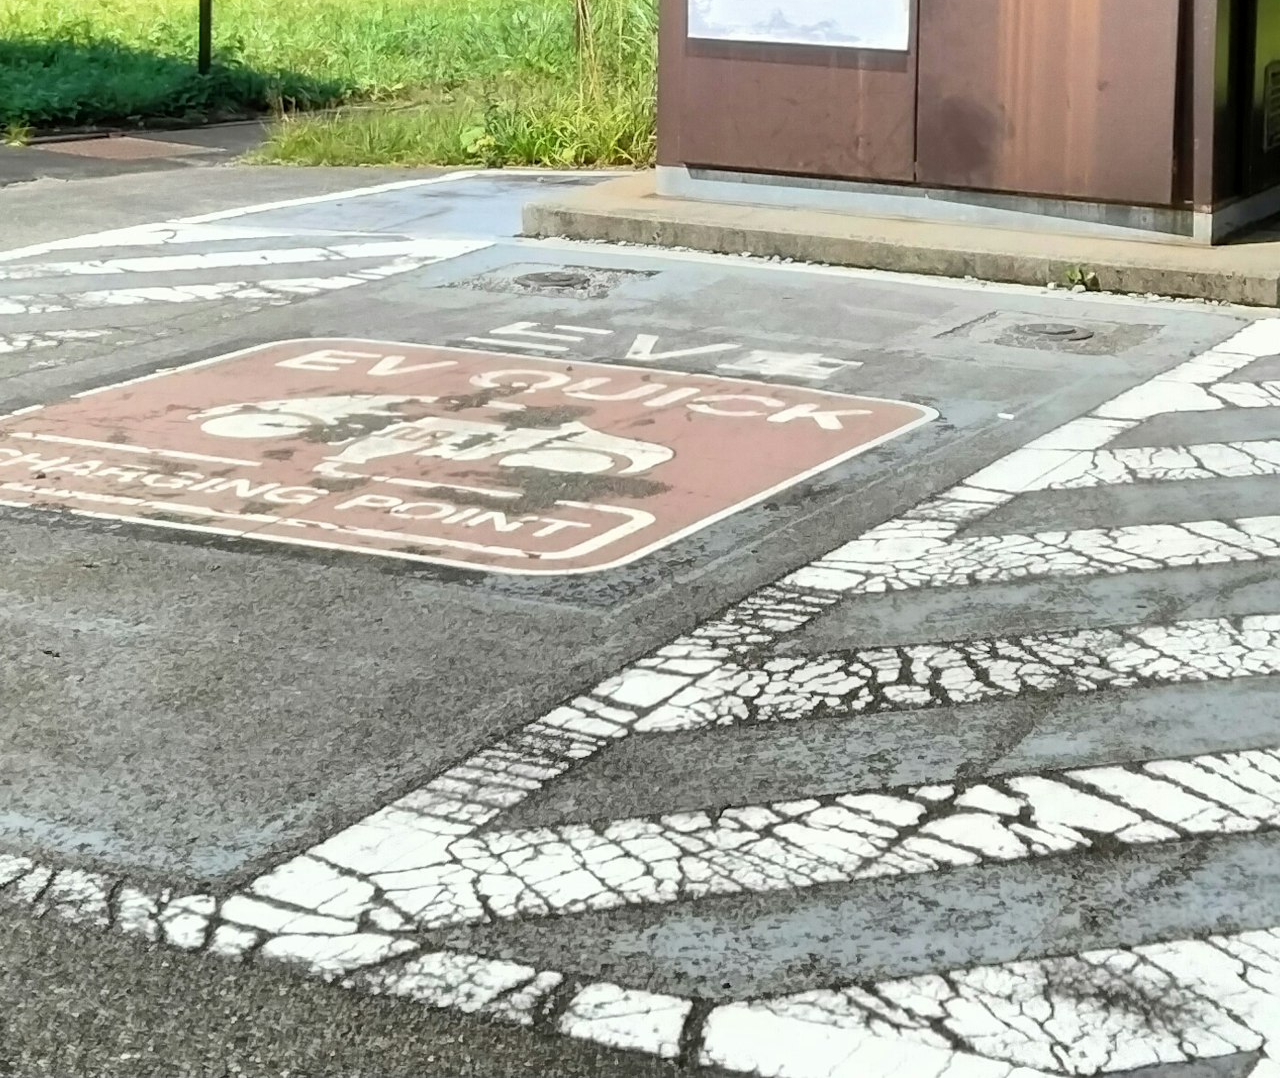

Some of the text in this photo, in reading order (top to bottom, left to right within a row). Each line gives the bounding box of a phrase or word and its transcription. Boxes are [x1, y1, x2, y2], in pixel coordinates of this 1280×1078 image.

[275, 349, 872, 430] EV QUICK
[333, 493, 592, 538] POINT
